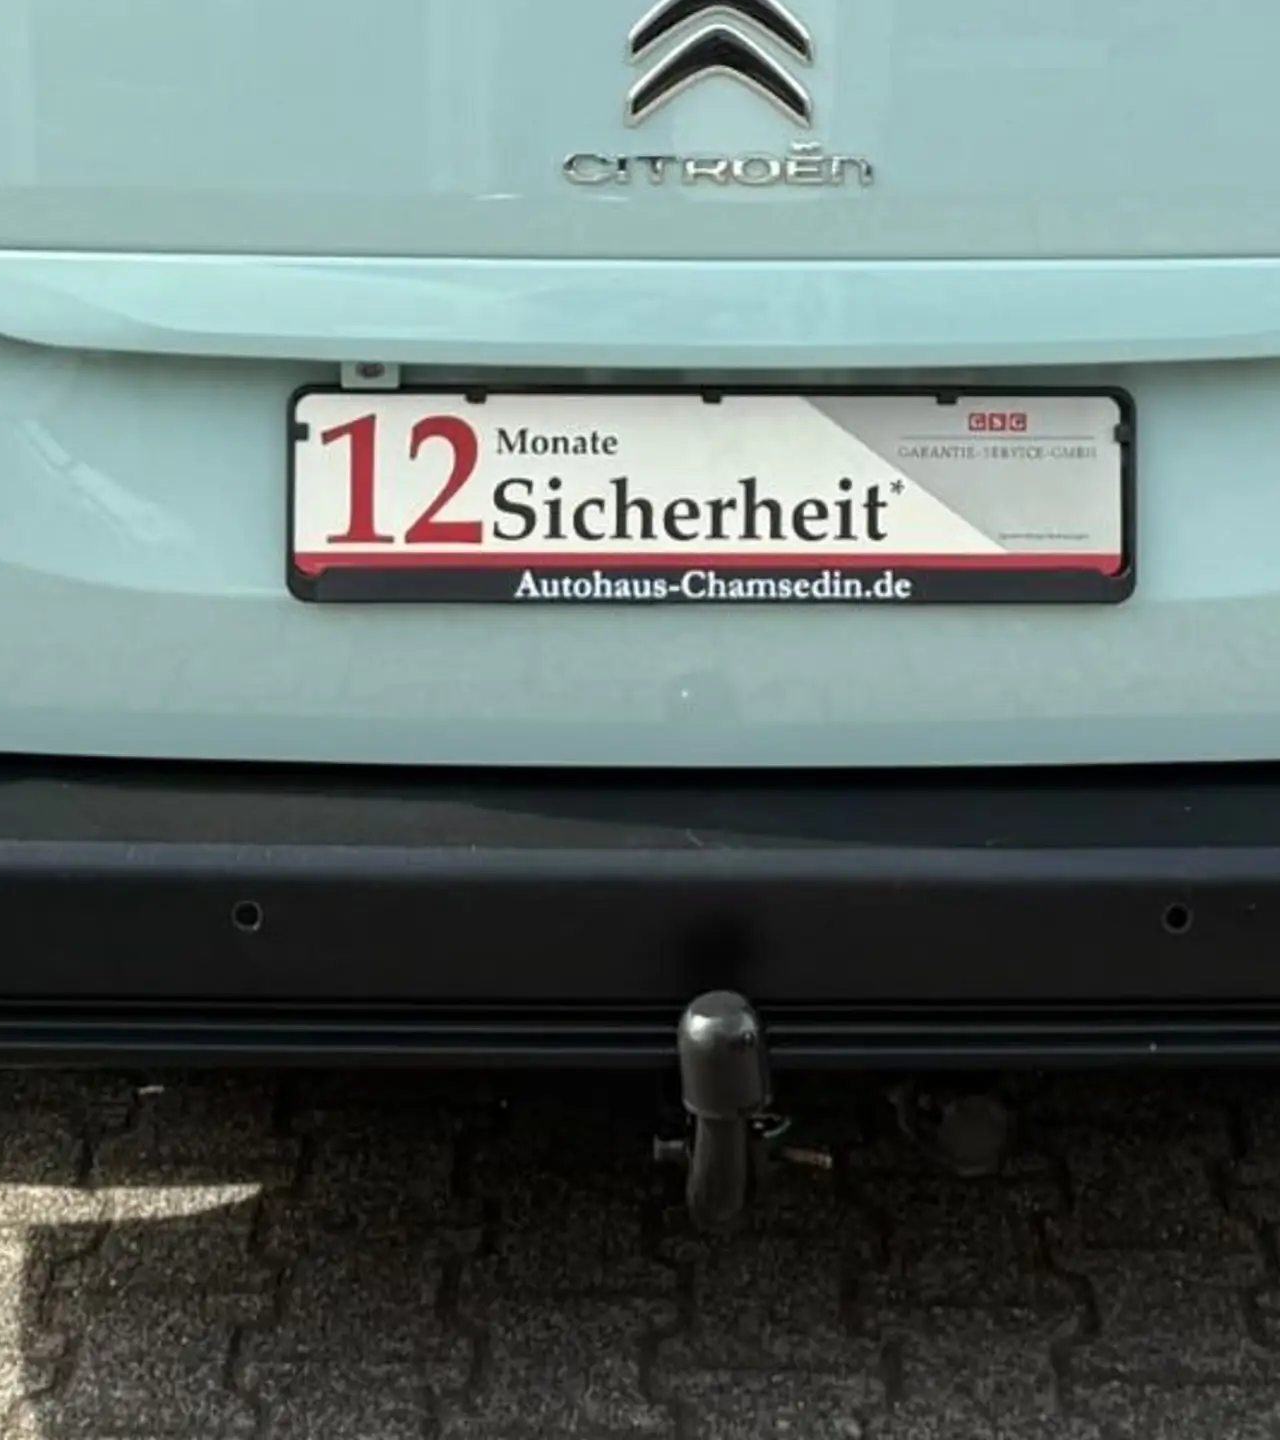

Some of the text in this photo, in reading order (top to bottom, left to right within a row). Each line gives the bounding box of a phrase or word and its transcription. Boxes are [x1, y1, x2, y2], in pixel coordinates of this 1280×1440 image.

[496, 427, 618, 456] Monate
[320, 413, 483, 545] 12
[514, 570, 913, 599] Autohaus-Chamsedin.de
